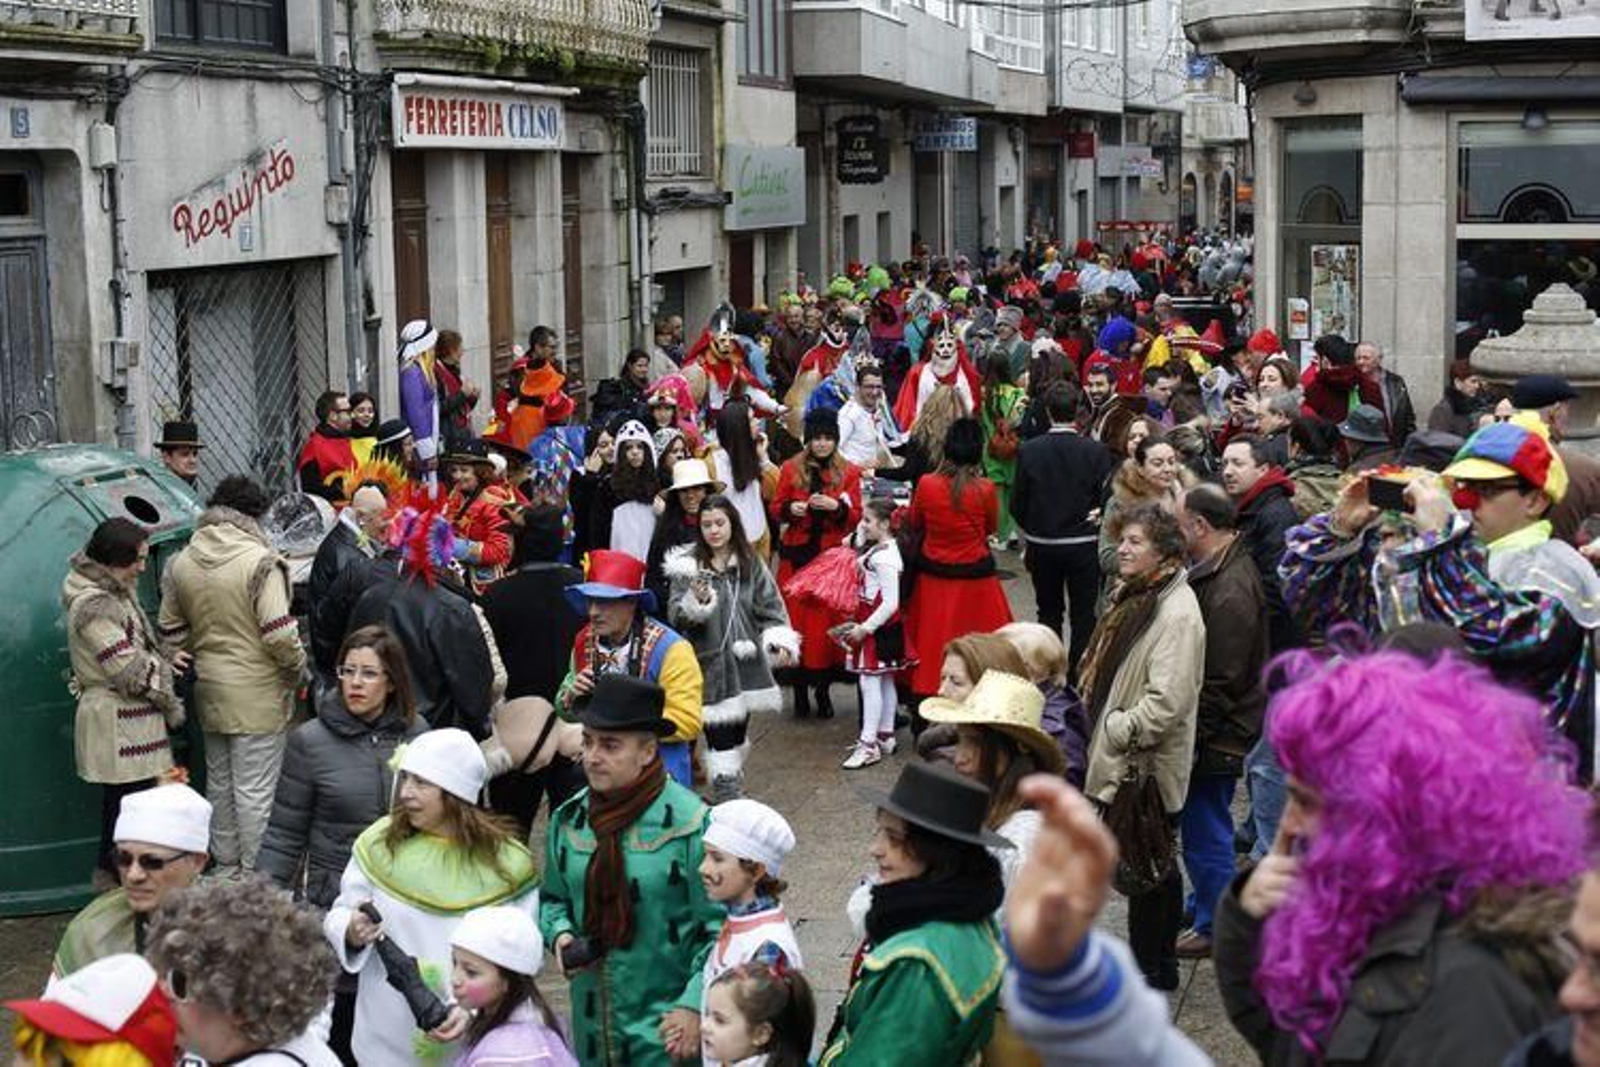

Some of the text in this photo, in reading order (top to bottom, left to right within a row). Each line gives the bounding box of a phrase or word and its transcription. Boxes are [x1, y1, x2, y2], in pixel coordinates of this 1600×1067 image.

[404, 95, 558, 138] FERRETERIA CELSO
[173, 148, 295, 249] Requinto
